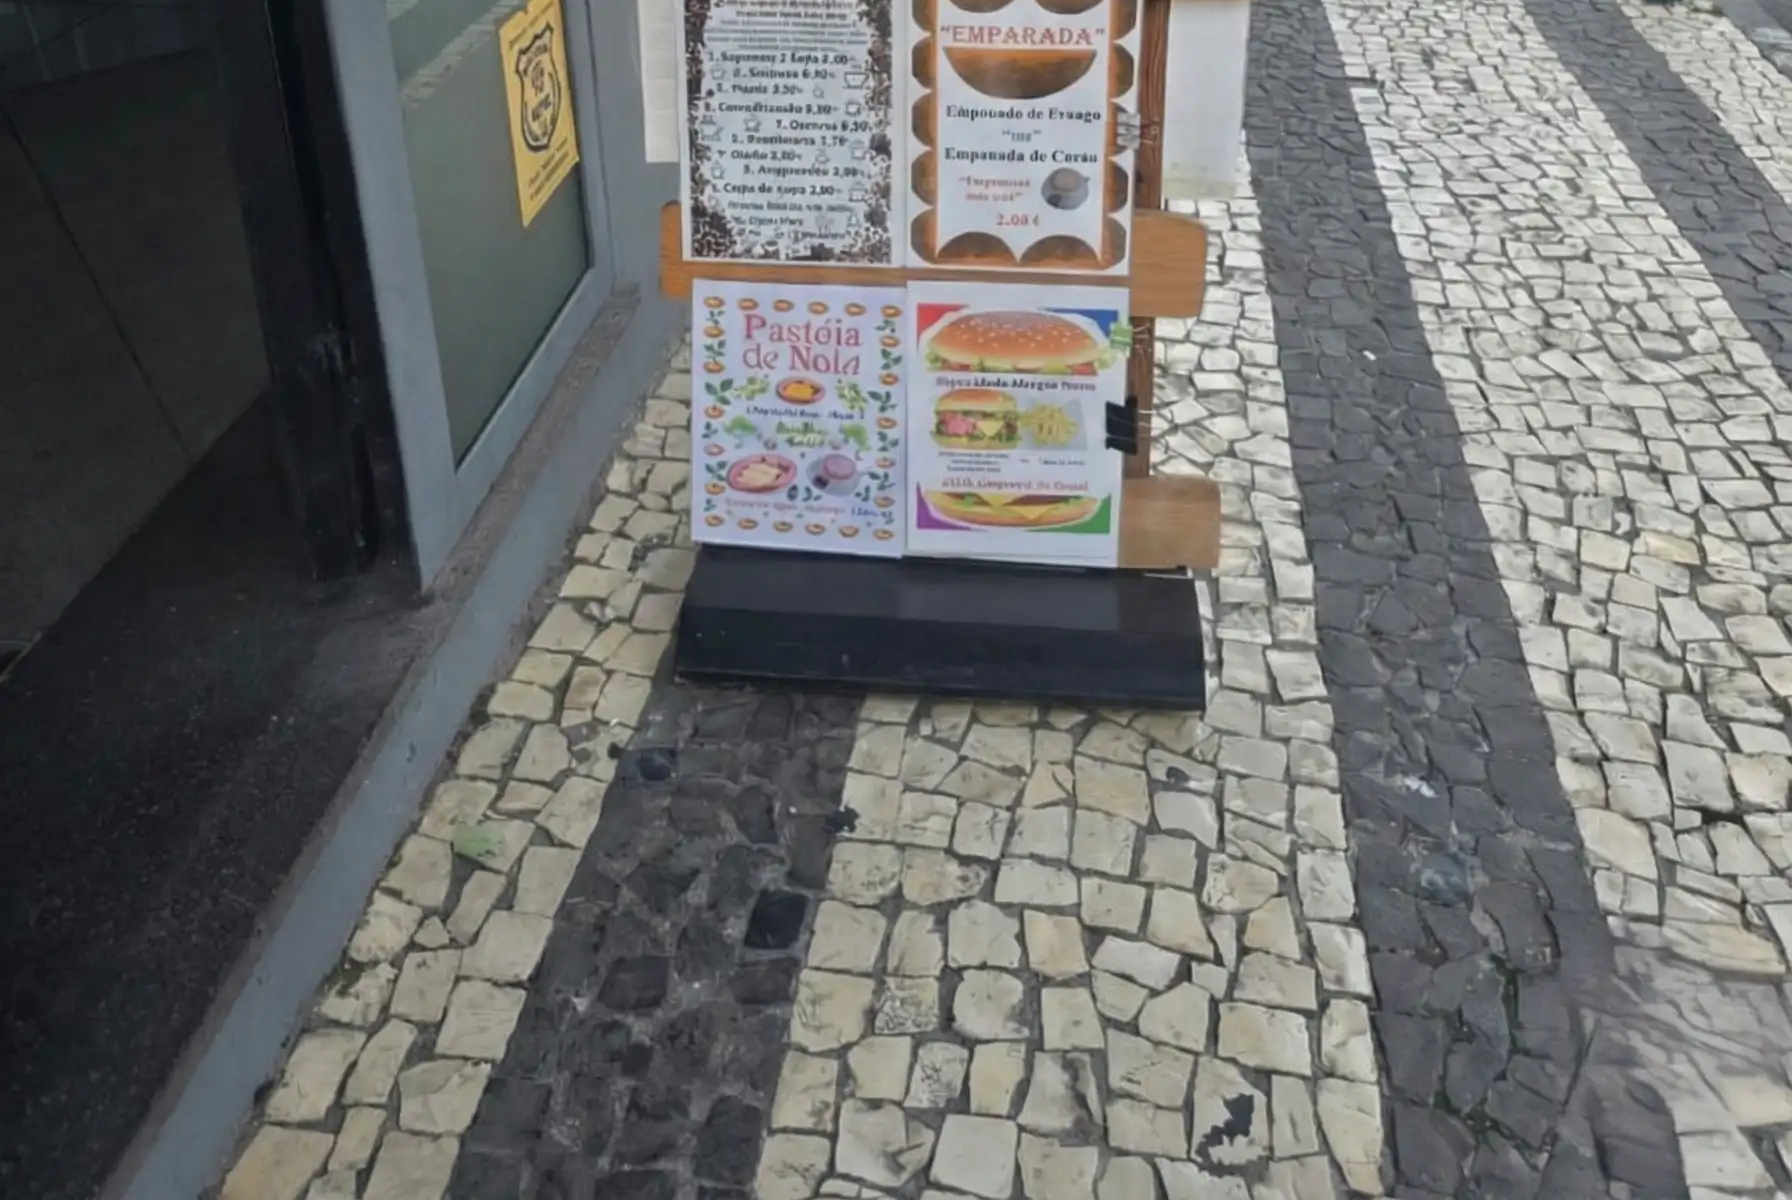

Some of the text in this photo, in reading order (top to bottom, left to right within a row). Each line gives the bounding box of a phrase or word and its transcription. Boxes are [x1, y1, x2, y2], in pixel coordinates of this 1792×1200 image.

[1027, 105, 1044, 119] de
[1029, 148, 1047, 162] de
[742, 343, 780, 372] de
